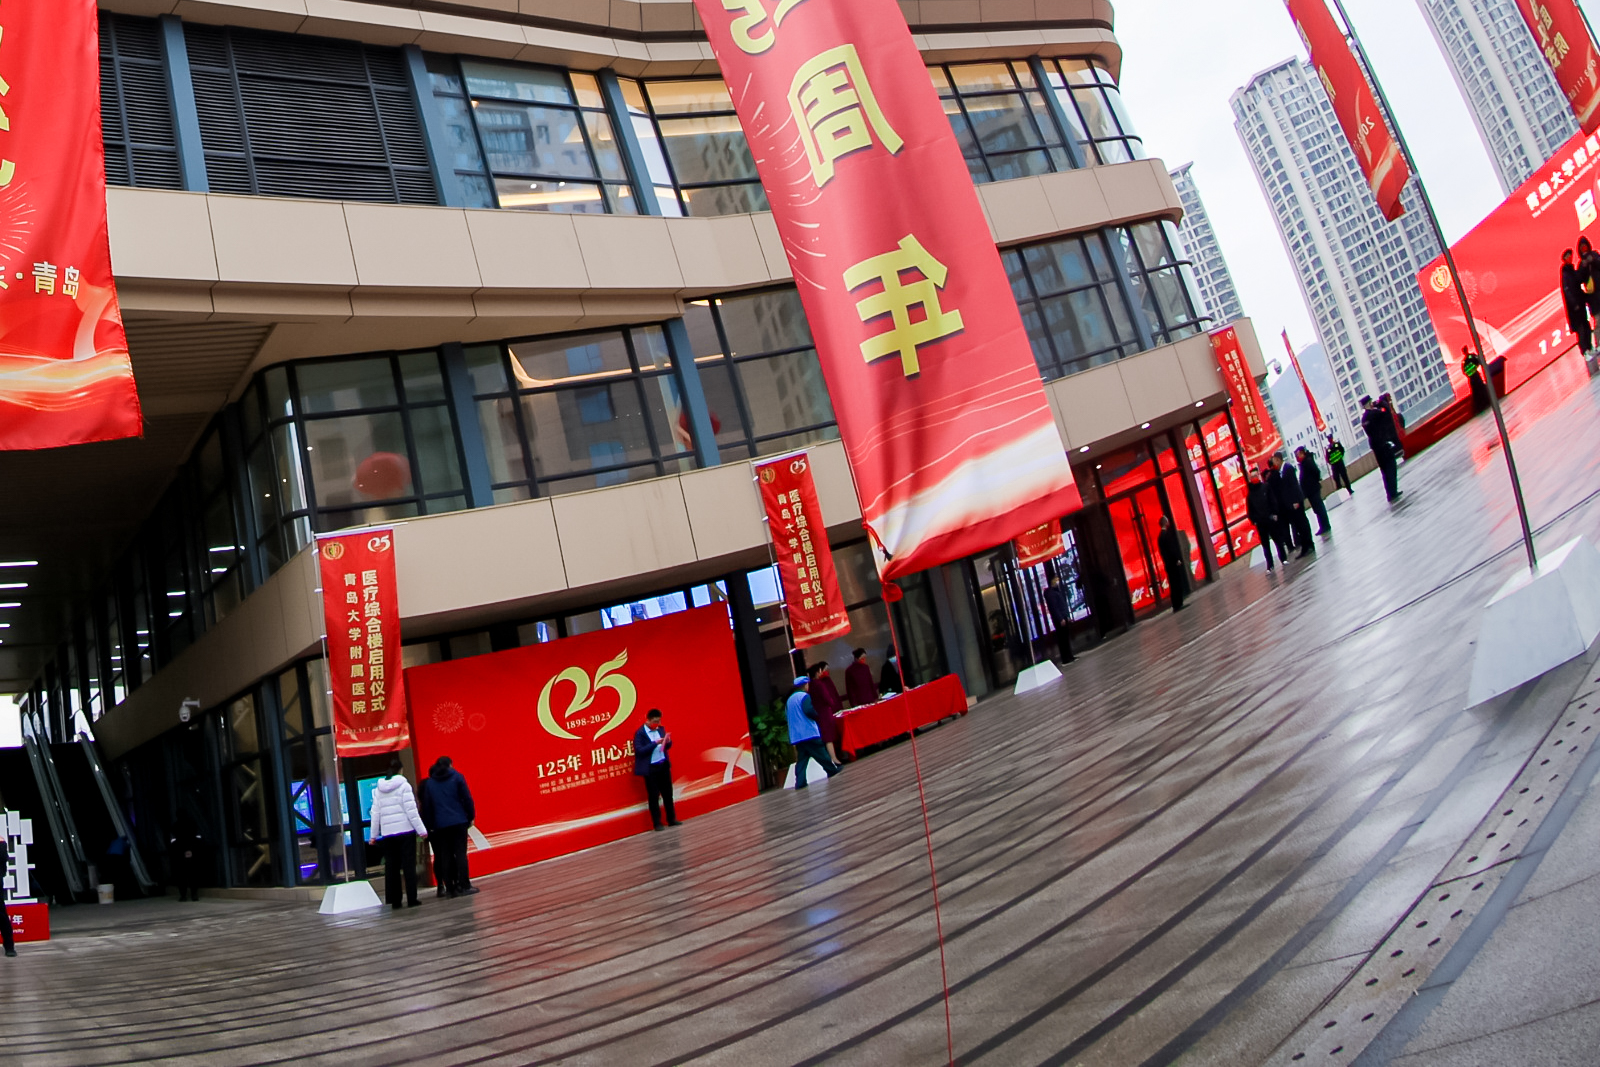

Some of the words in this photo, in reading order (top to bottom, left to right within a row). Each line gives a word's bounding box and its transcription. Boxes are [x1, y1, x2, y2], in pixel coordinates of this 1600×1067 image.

[1538, 326, 1572, 356] 12
[777, 493, 814, 610] 青岛大学附属医院
[788, 489, 826, 607] 医疗综合楼启用仪式
[344, 573, 367, 714] 青岛大学附属医院
[361, 570, 386, 712] 医疗综合楼启用仪式
[536, 754, 583, 779] 125年
[566, 711, 611, 730] 1898-2023
